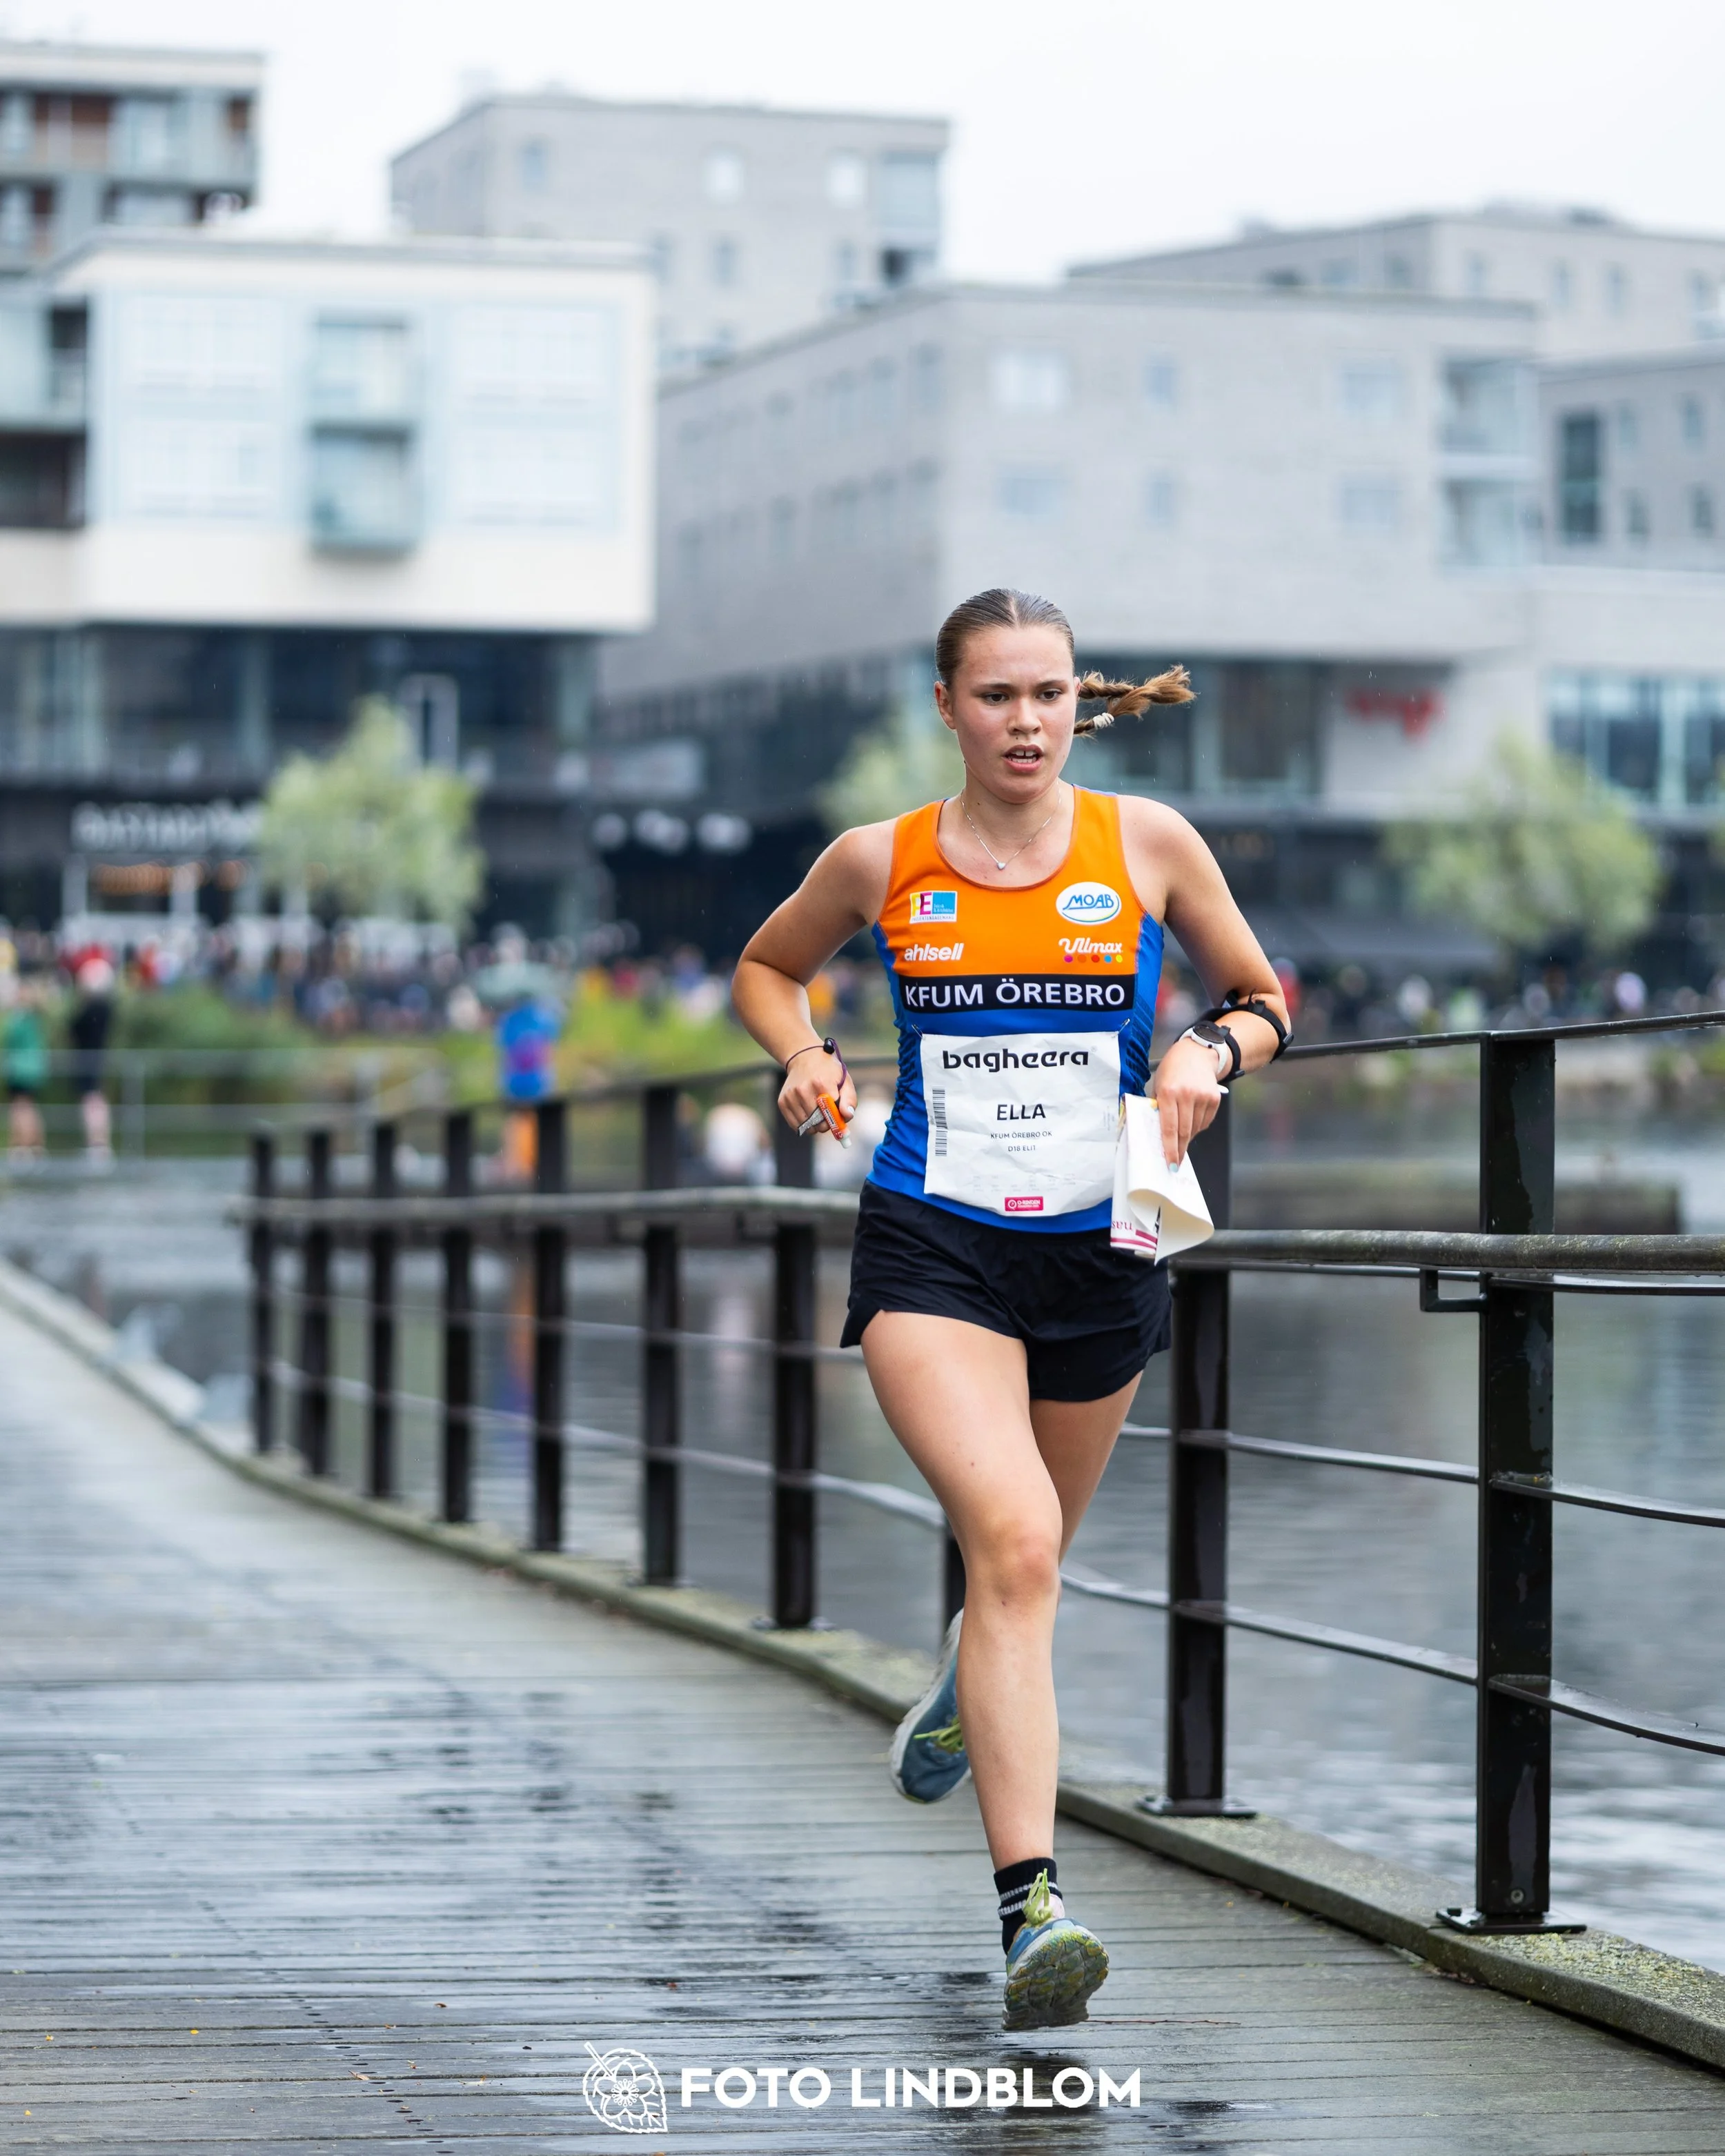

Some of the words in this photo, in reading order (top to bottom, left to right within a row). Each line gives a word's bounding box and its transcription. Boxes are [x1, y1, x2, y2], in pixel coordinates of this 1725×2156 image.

[1063, 894, 1114, 910] MOAB
[905, 943, 964, 961] ahlsell
[1058, 938, 1123, 953] Ullmax
[905, 983, 983, 1007] KFUM
[996, 978, 1125, 1005] ÖREBRO
[943, 1048, 1089, 1073] bagheera
[997, 1103, 1046, 1120] ELLA
[1012, 1130, 1041, 1138] ÖREBRO
